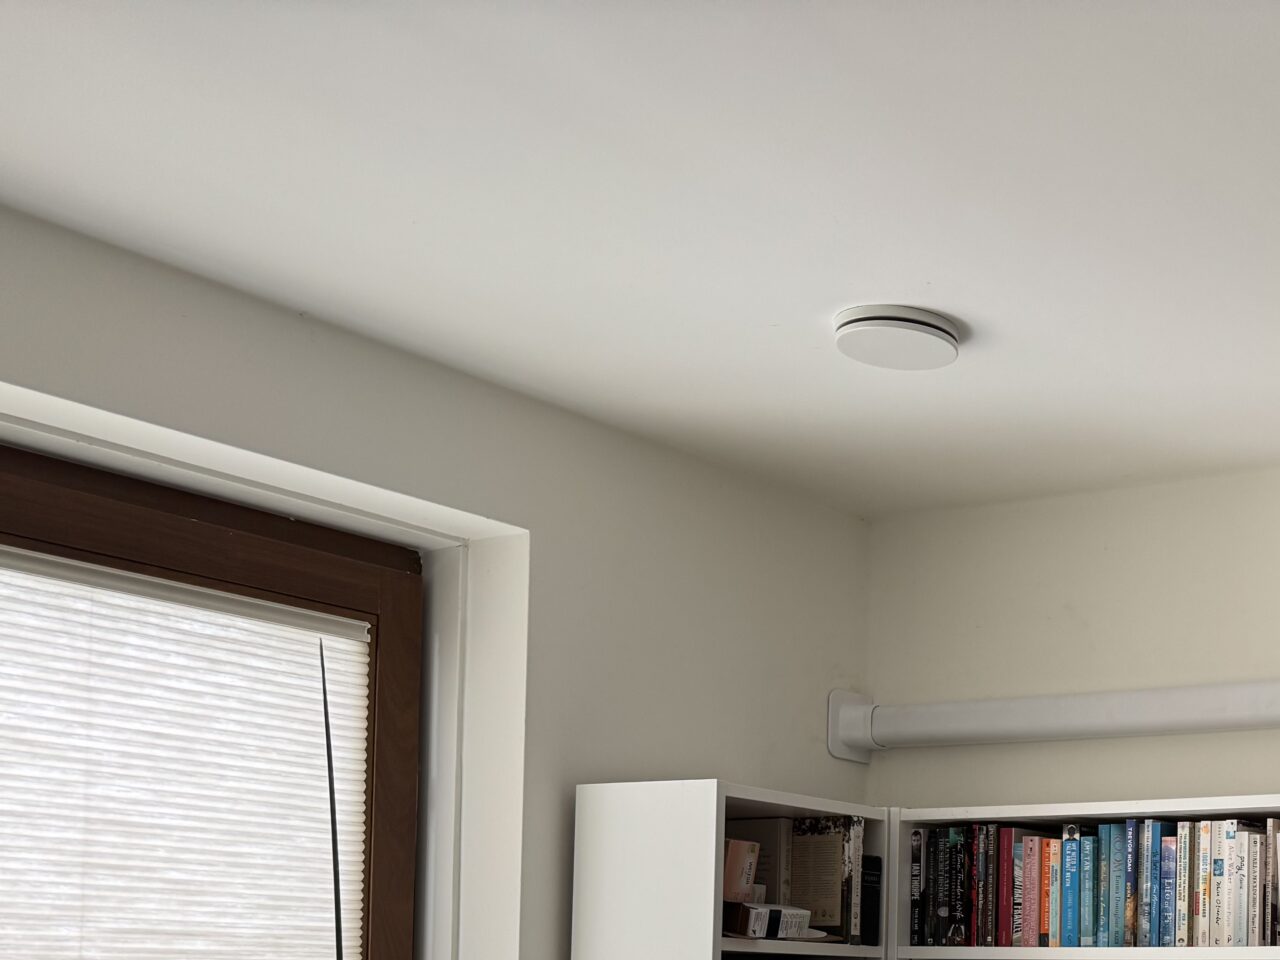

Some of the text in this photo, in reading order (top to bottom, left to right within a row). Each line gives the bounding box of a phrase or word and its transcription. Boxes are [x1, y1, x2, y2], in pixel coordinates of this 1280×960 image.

[912, 863, 920, 900] IAN THORPE
[1164, 879, 1172, 900] Life
[1164, 913, 1172, 923] Pi
